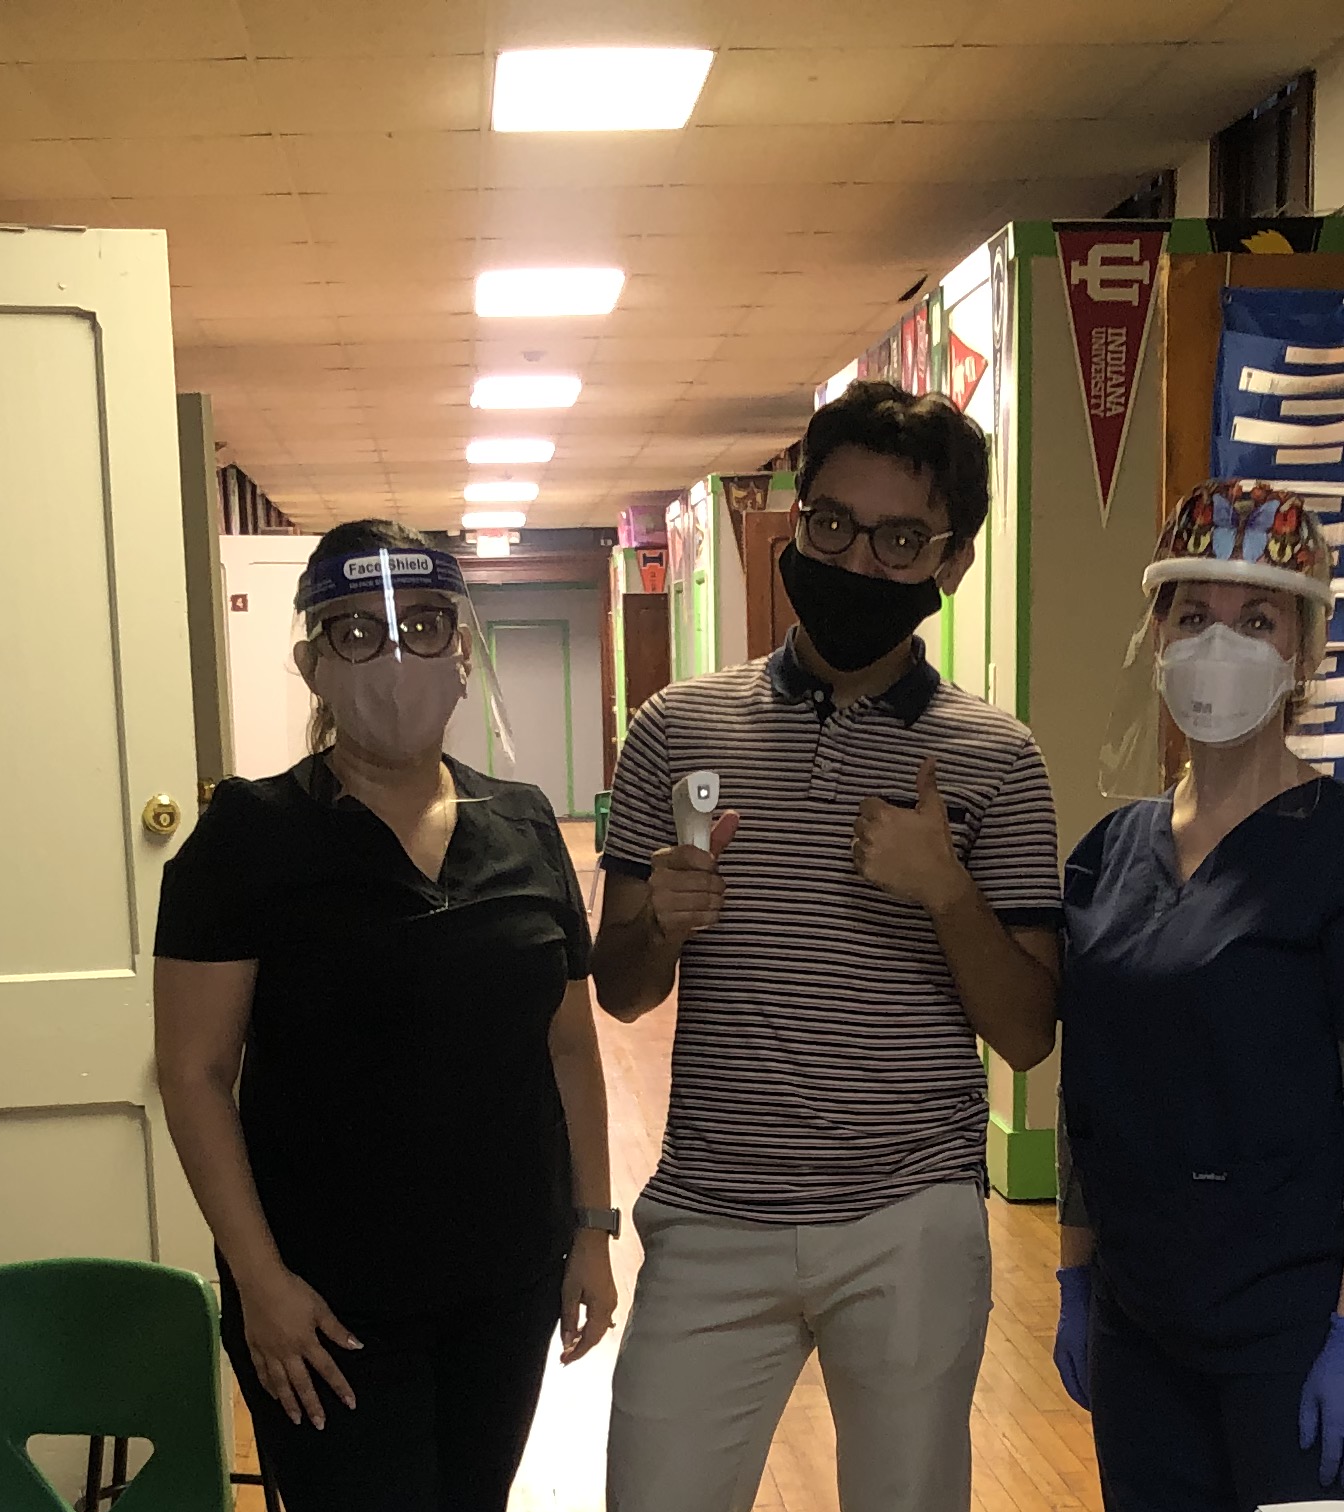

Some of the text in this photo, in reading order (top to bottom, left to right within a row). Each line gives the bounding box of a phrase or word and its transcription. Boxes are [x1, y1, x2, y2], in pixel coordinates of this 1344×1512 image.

[1090, 327, 1106, 418] UNIVERSITY
[1106, 326, 1127, 417] INDIANA
[349, 562, 382, 576] Face
[388, 556, 429, 572] Shield
